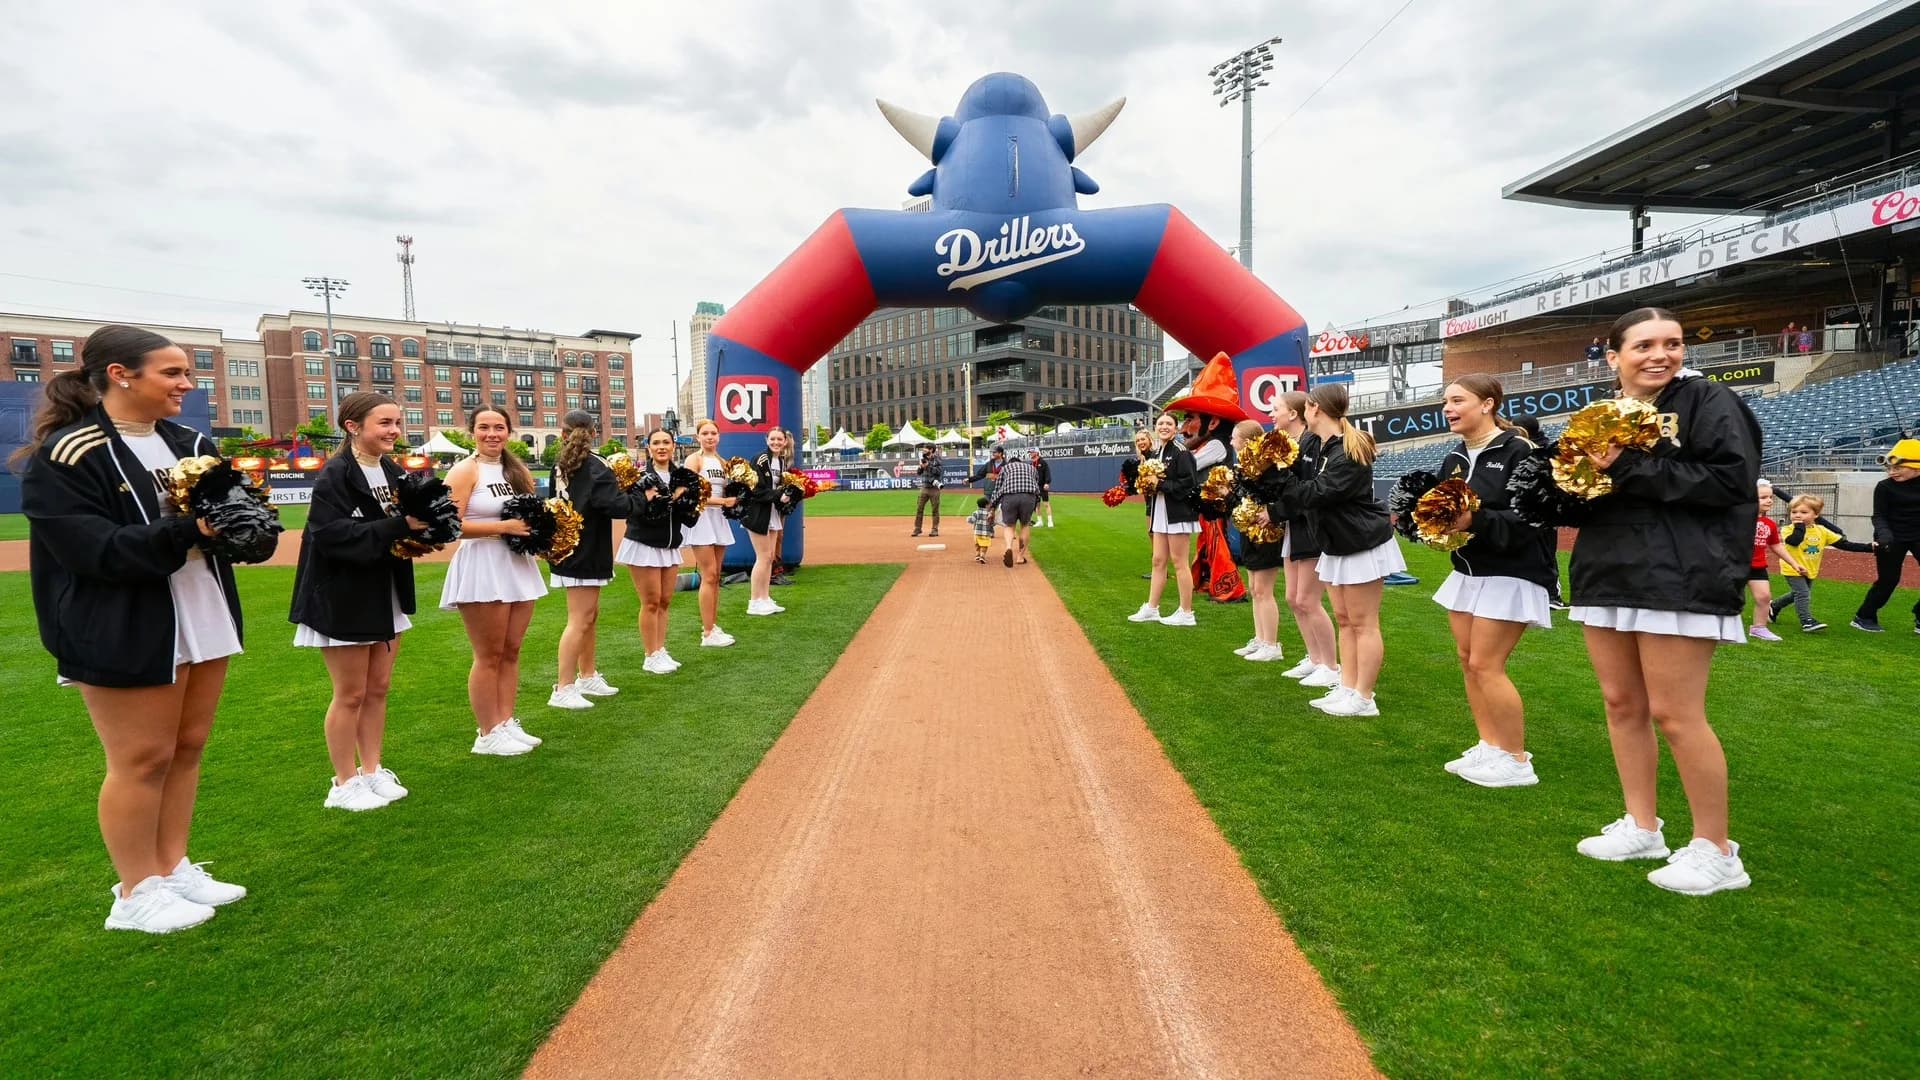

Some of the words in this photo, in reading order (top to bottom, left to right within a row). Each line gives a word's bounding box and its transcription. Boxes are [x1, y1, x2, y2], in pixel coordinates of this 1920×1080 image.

[1872, 191, 1920, 225] Co
[935, 216, 1085, 291] Drillers
[1537, 259, 1673, 311] REFINERY
[1698, 223, 1800, 269] DECK
[1446, 318, 1477, 336] Coors
[1478, 310, 1508, 327] LIGHT
[1312, 331, 1369, 353] Coors
[1370, 324, 1428, 347] LIGHT
[720, 383, 771, 425] QT
[1388, 411, 1446, 435] CASI
[1054, 448, 1073, 457] RESORT
[1084, 445, 1100, 456] Party
[1101, 444, 1130, 456] Platform
[486, 482, 517, 497] TIGE
[850, 480, 865, 490] THE
[865, 479, 889, 489] PLACE
[891, 479, 901, 488] TO
[901, 479, 912, 488] BE
